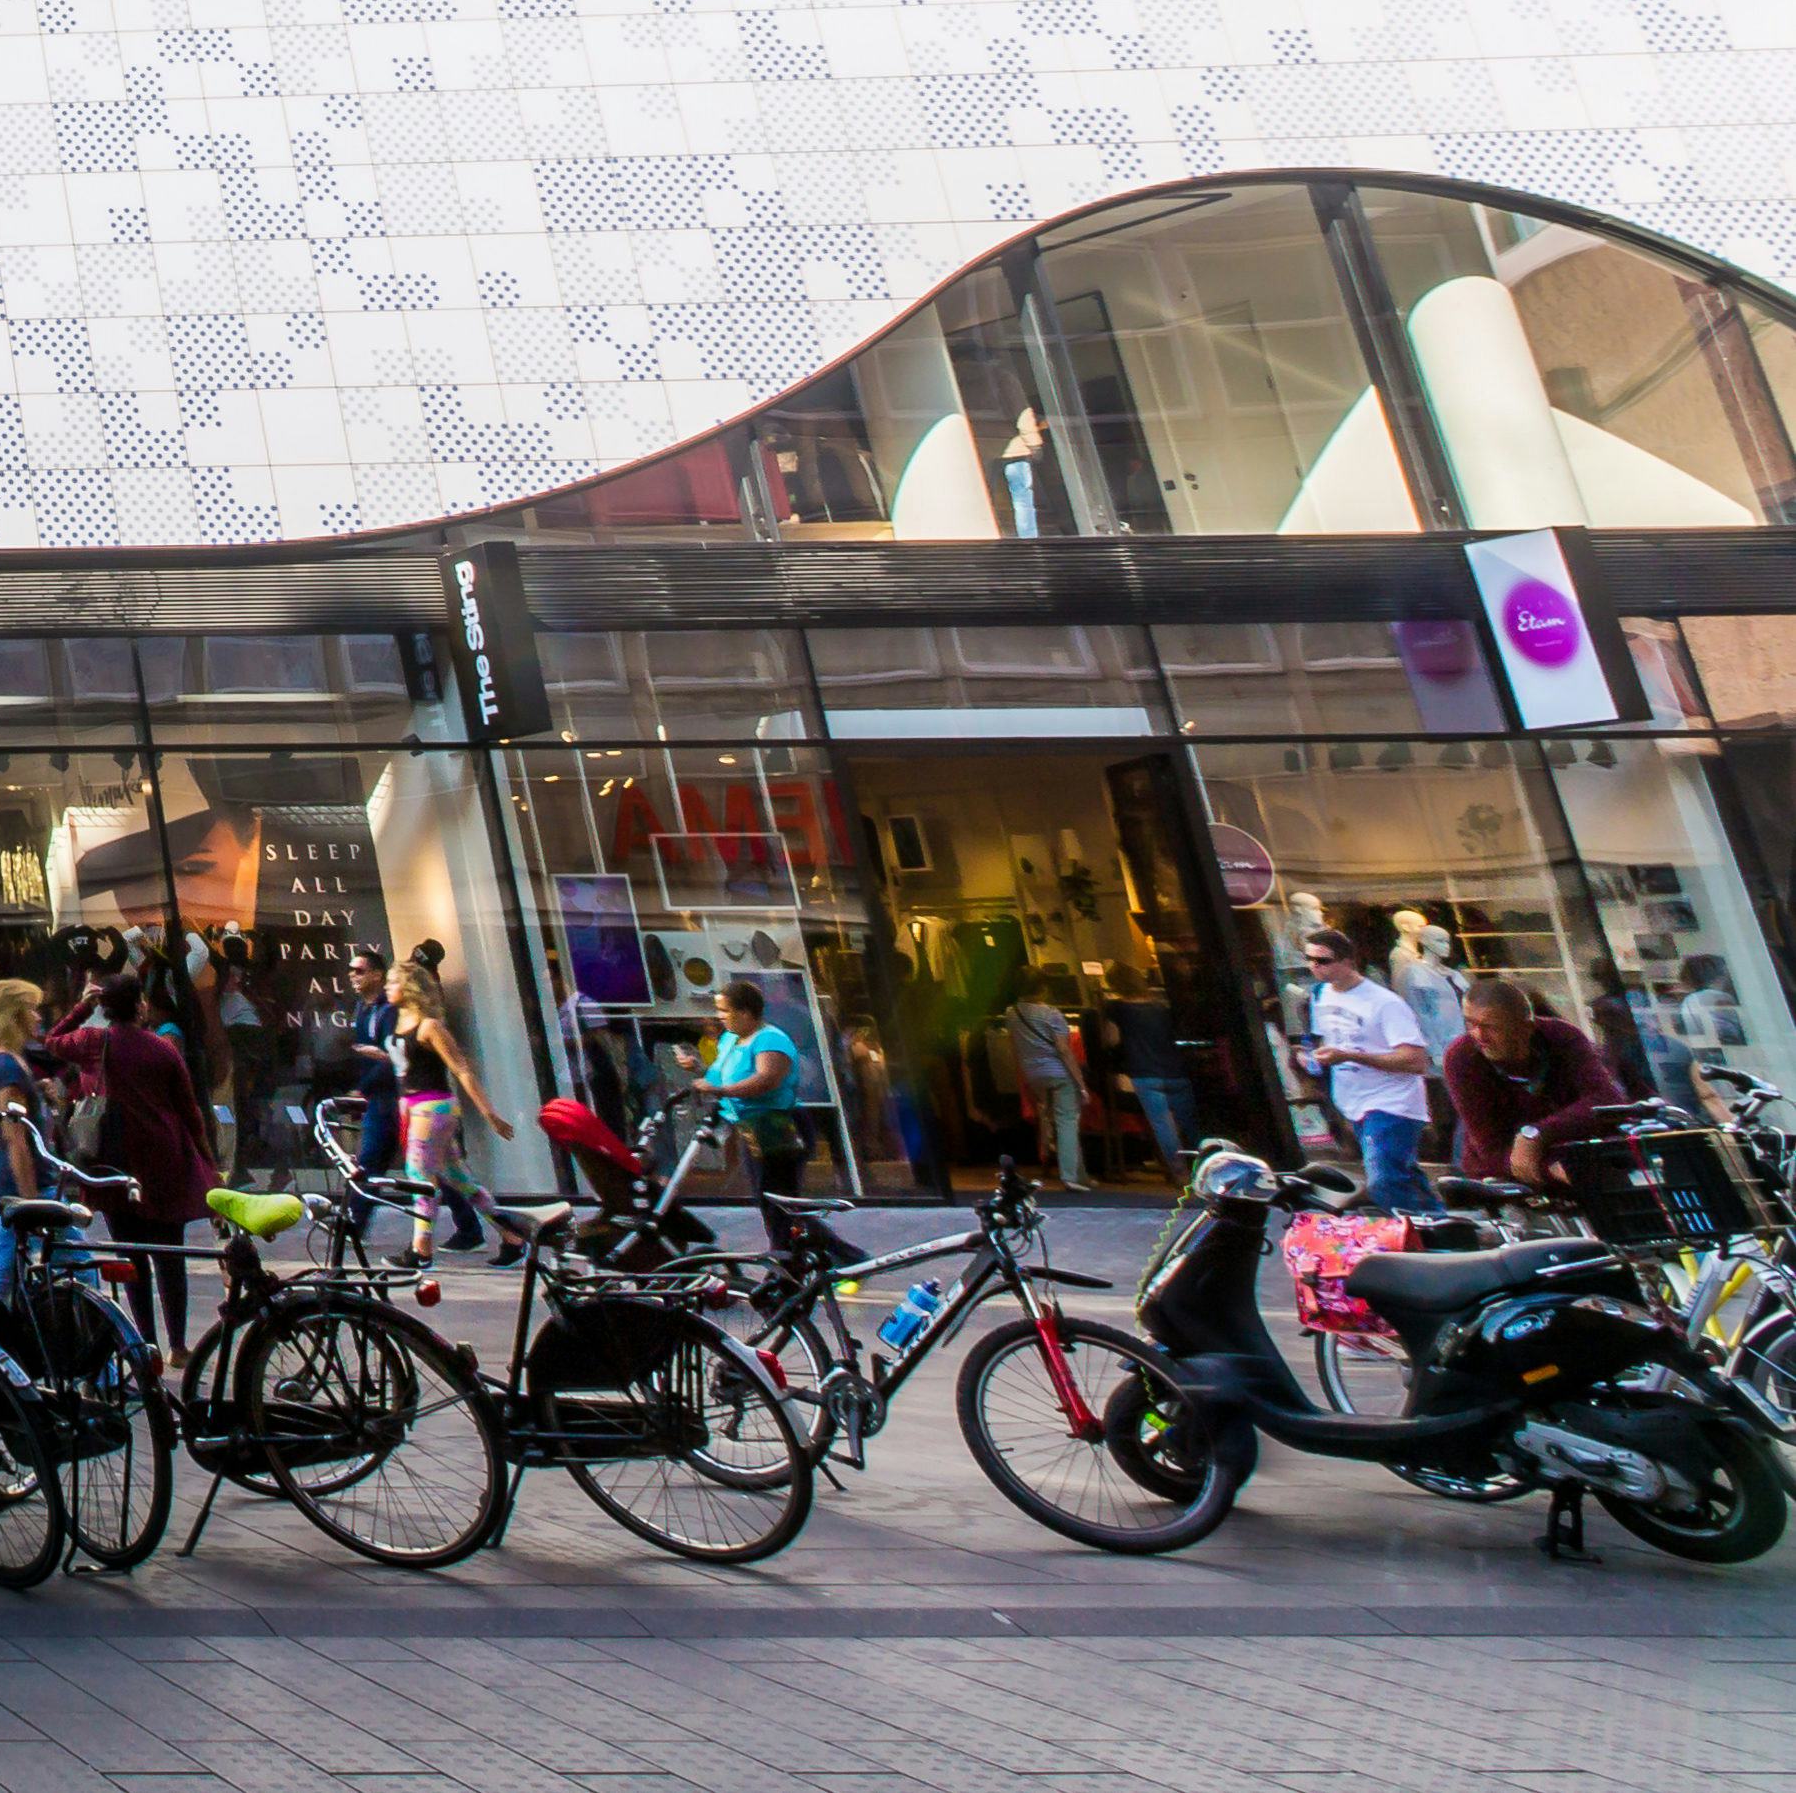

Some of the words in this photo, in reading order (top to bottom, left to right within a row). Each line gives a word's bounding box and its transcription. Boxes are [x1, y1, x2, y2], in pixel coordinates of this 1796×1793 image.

[455, 560, 485, 651] Sting
[476, 654, 499, 726] The
[265, 844, 361, 861] SLEEP
[291, 876, 348, 894] ALL
[294, 909, 355, 927] DAY
[309, 976, 345, 994] AL
[286, 1011, 349, 1028] NIG
